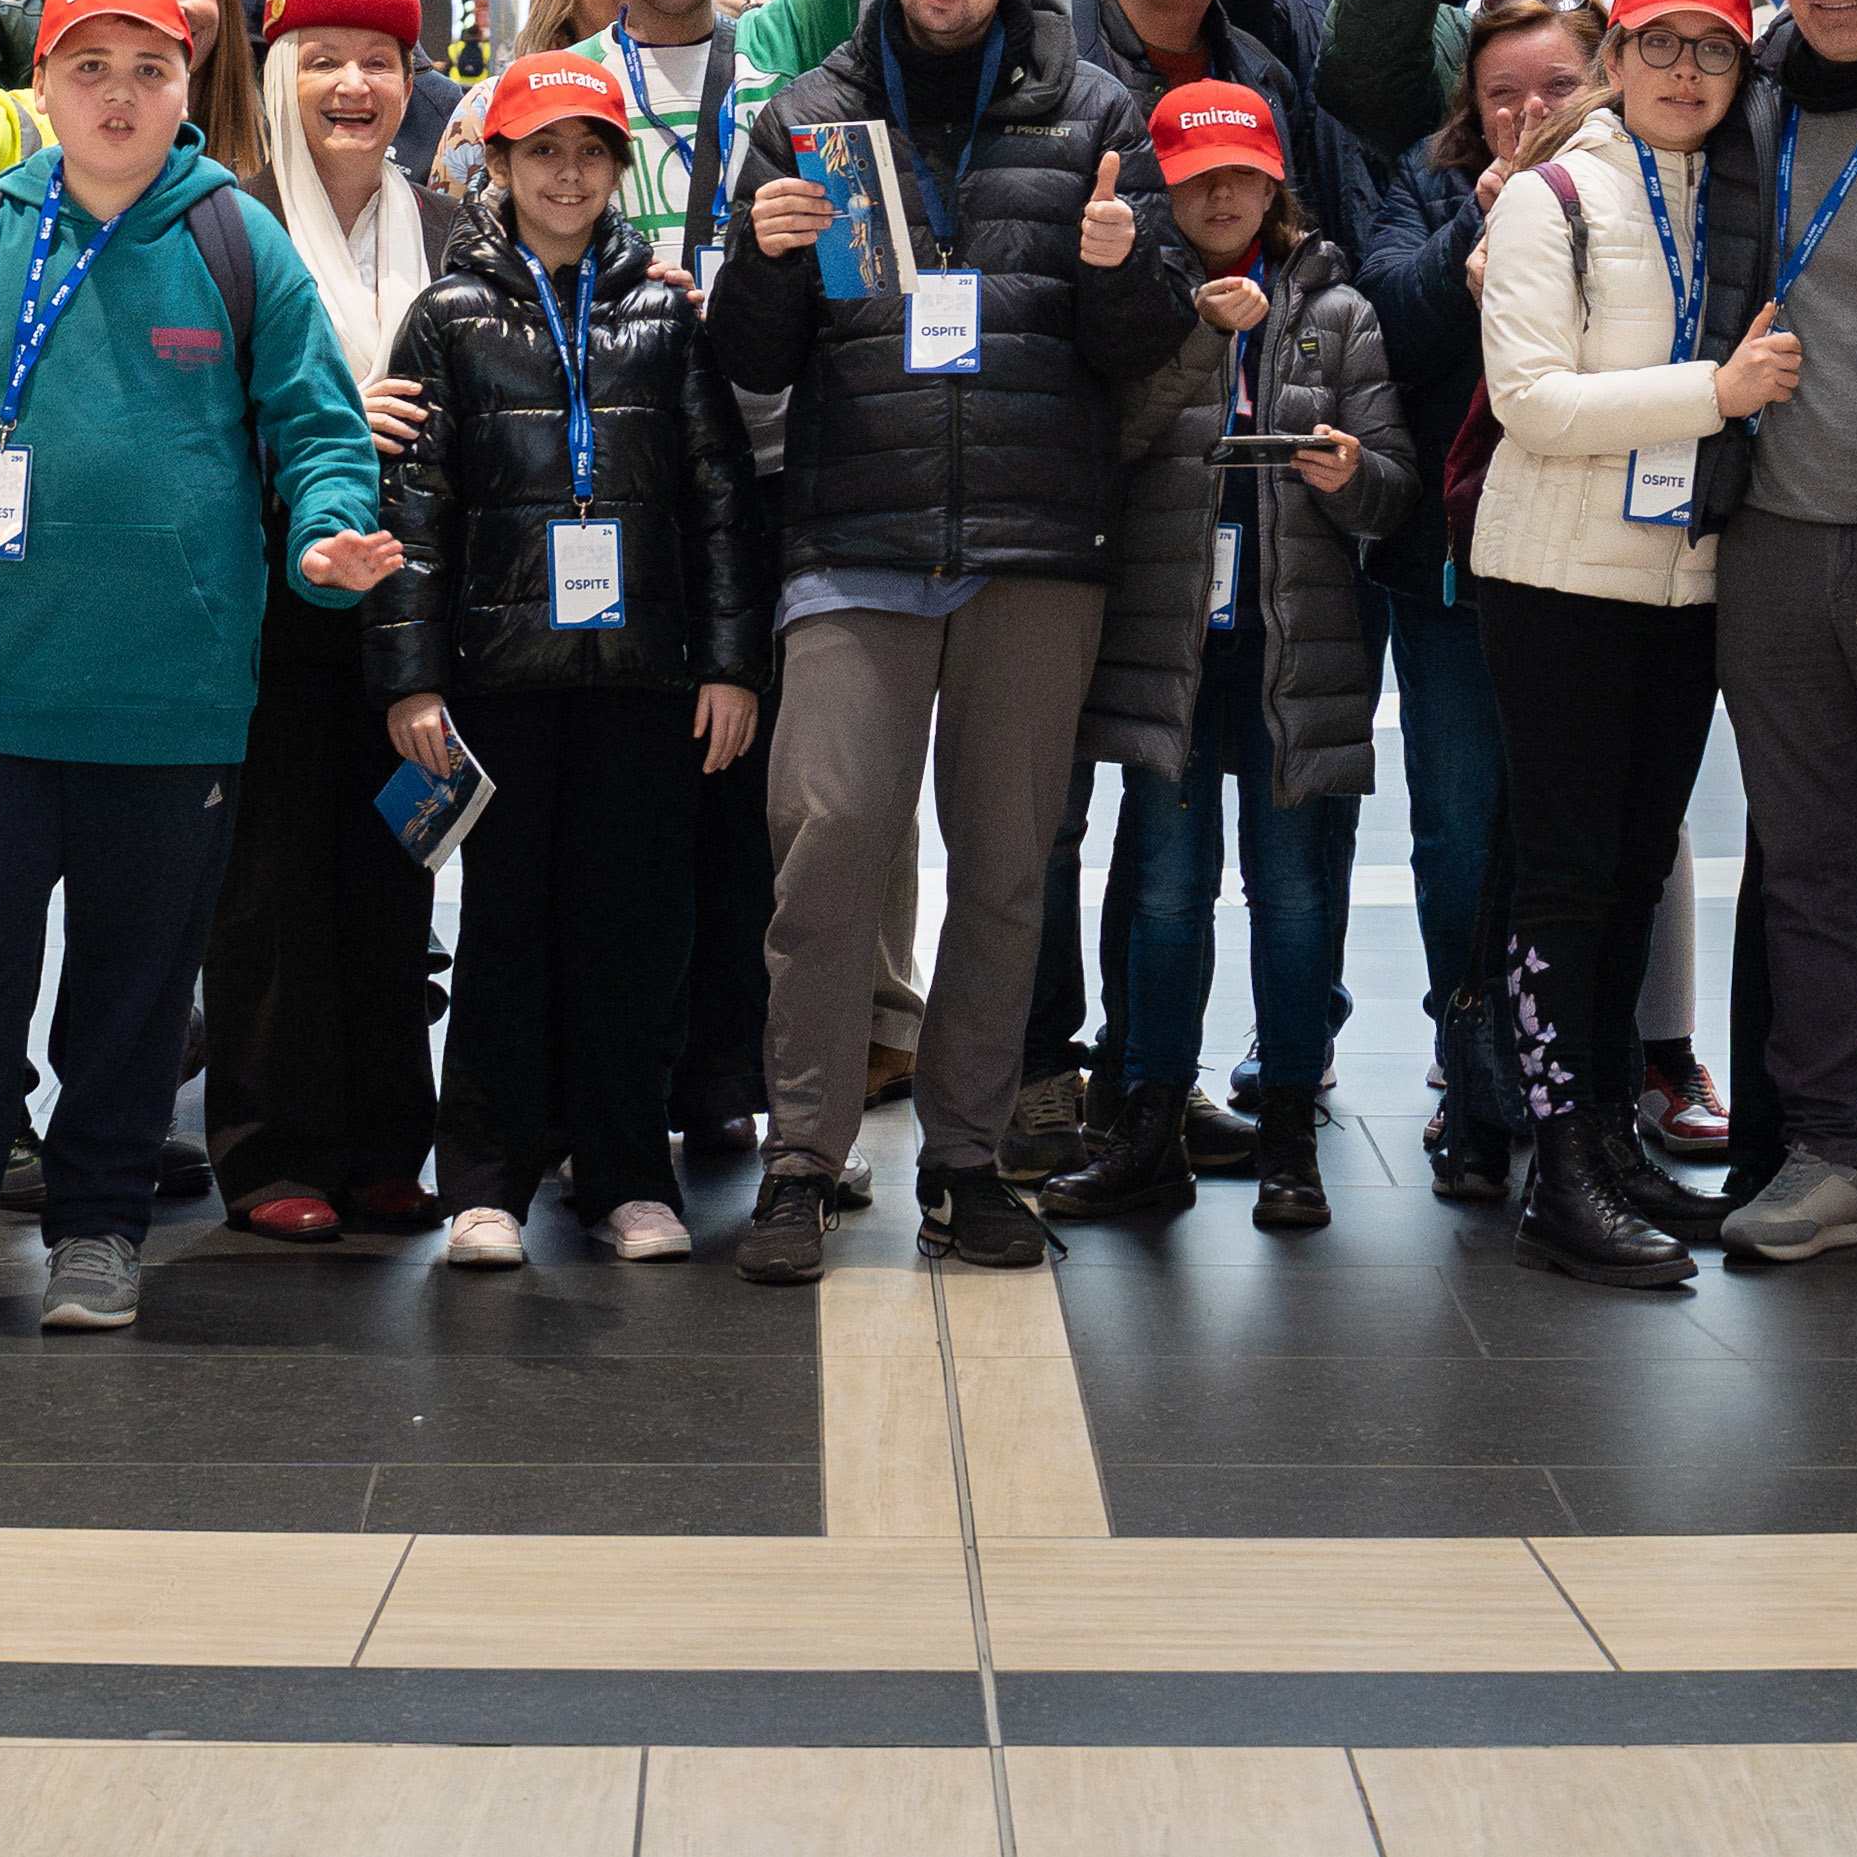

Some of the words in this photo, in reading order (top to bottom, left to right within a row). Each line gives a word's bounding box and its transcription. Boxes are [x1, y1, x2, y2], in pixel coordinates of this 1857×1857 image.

[528, 68, 608, 95] Emirates
[1180, 107, 1257, 130] Emirates
[1017, 126, 1072, 136] PROTEST
[1649, 175, 1661, 197] ADR
[40, 217, 53, 240] ADR
[1659, 216, 1670, 238] ADR
[30, 258, 44, 281] ADR
[76, 248, 94, 270] ADR
[1669, 255, 1681, 278] ADR
[51, 285, 70, 306] ADR
[1691, 279, 1700, 300] ADR
[23, 300, 35, 323] ADR
[31, 323, 46, 346] ADR
[921, 326, 968, 337] OSPITE
[1684, 318, 1697, 339] ADR
[12, 364, 26, 387] ADR
[577, 451, 587, 476] ADR
[1642, 474, 1686, 488] OSPITE
[564, 578, 611, 590] OSPITE
